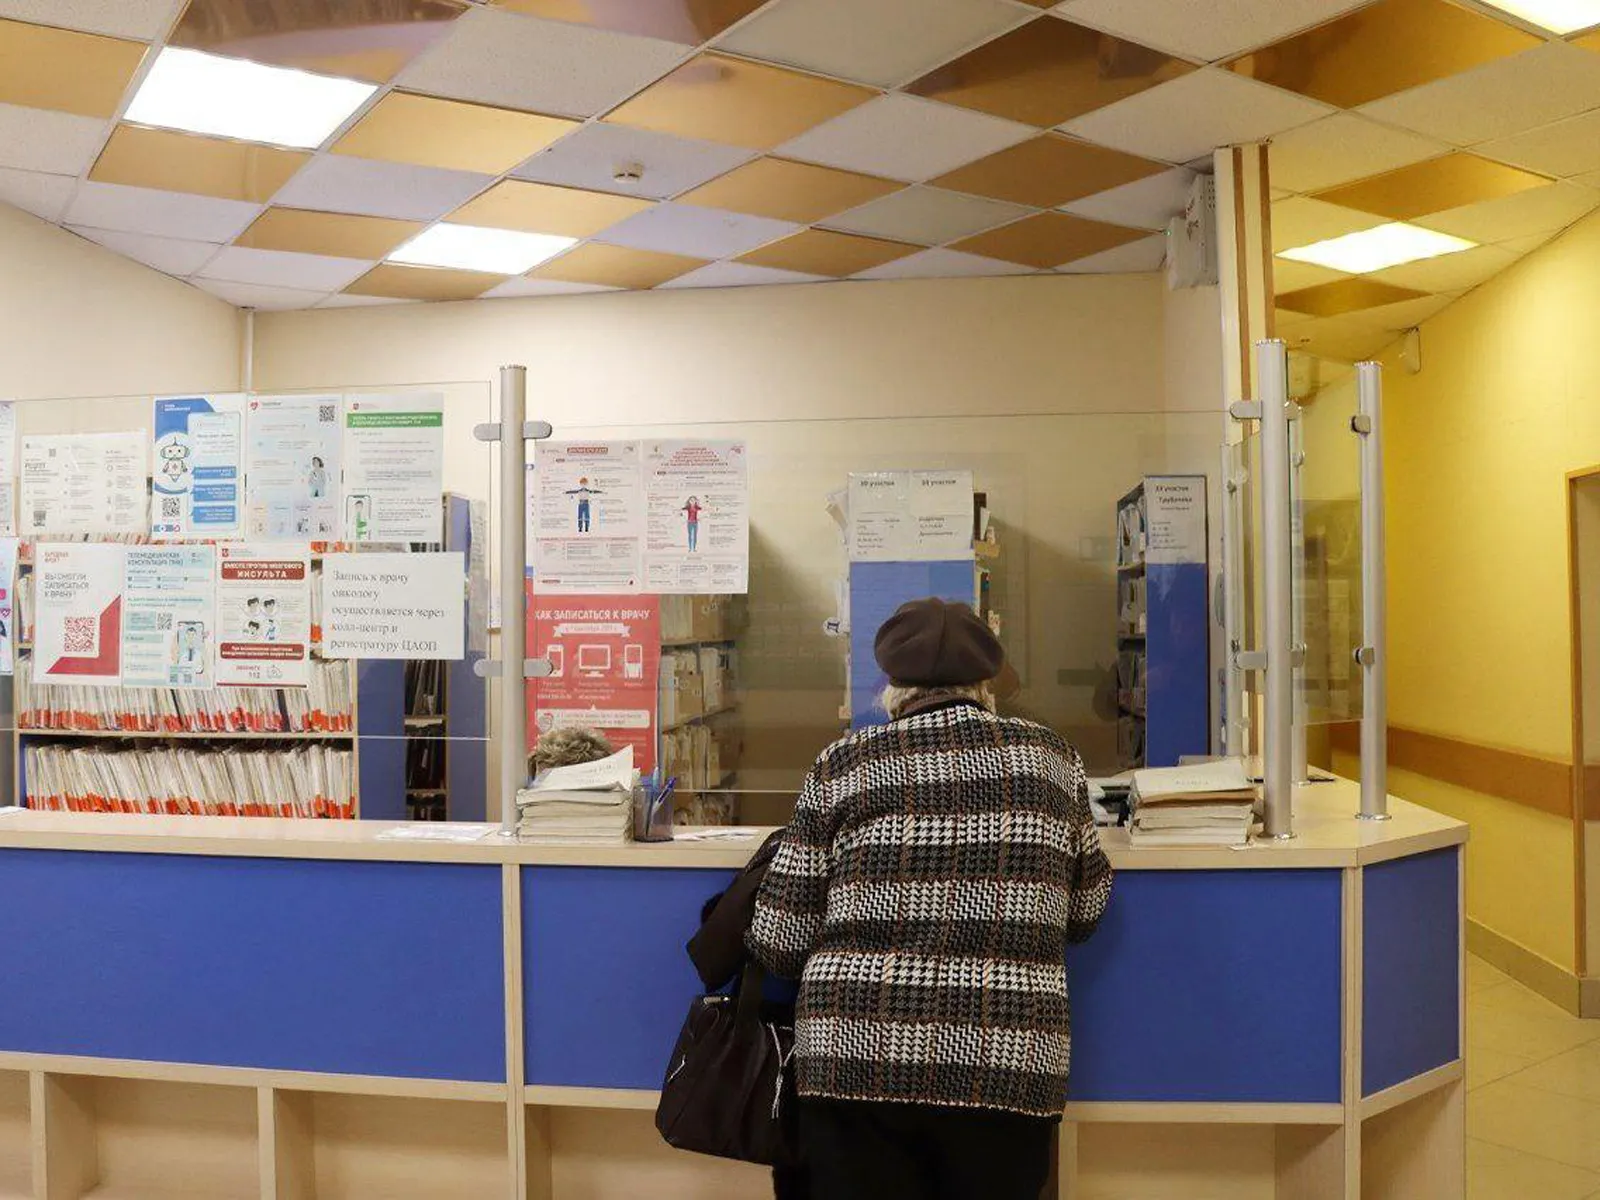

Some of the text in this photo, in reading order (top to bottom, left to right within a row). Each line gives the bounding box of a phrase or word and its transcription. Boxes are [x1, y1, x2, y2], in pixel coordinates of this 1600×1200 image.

[237, 570, 287, 578] ИНСУЛЬТА
[333, 570, 367, 581] Запись
[379, 574, 409, 584] врачу
[331, 590, 379, 601] онкологу
[331, 608, 445, 620] осуществляется через
[535, 610, 650, 620] КАК ЗАПИСАТЬСЯ К ВРАЧУ
[331, 640, 438, 652] регистратуру ЦАОП
